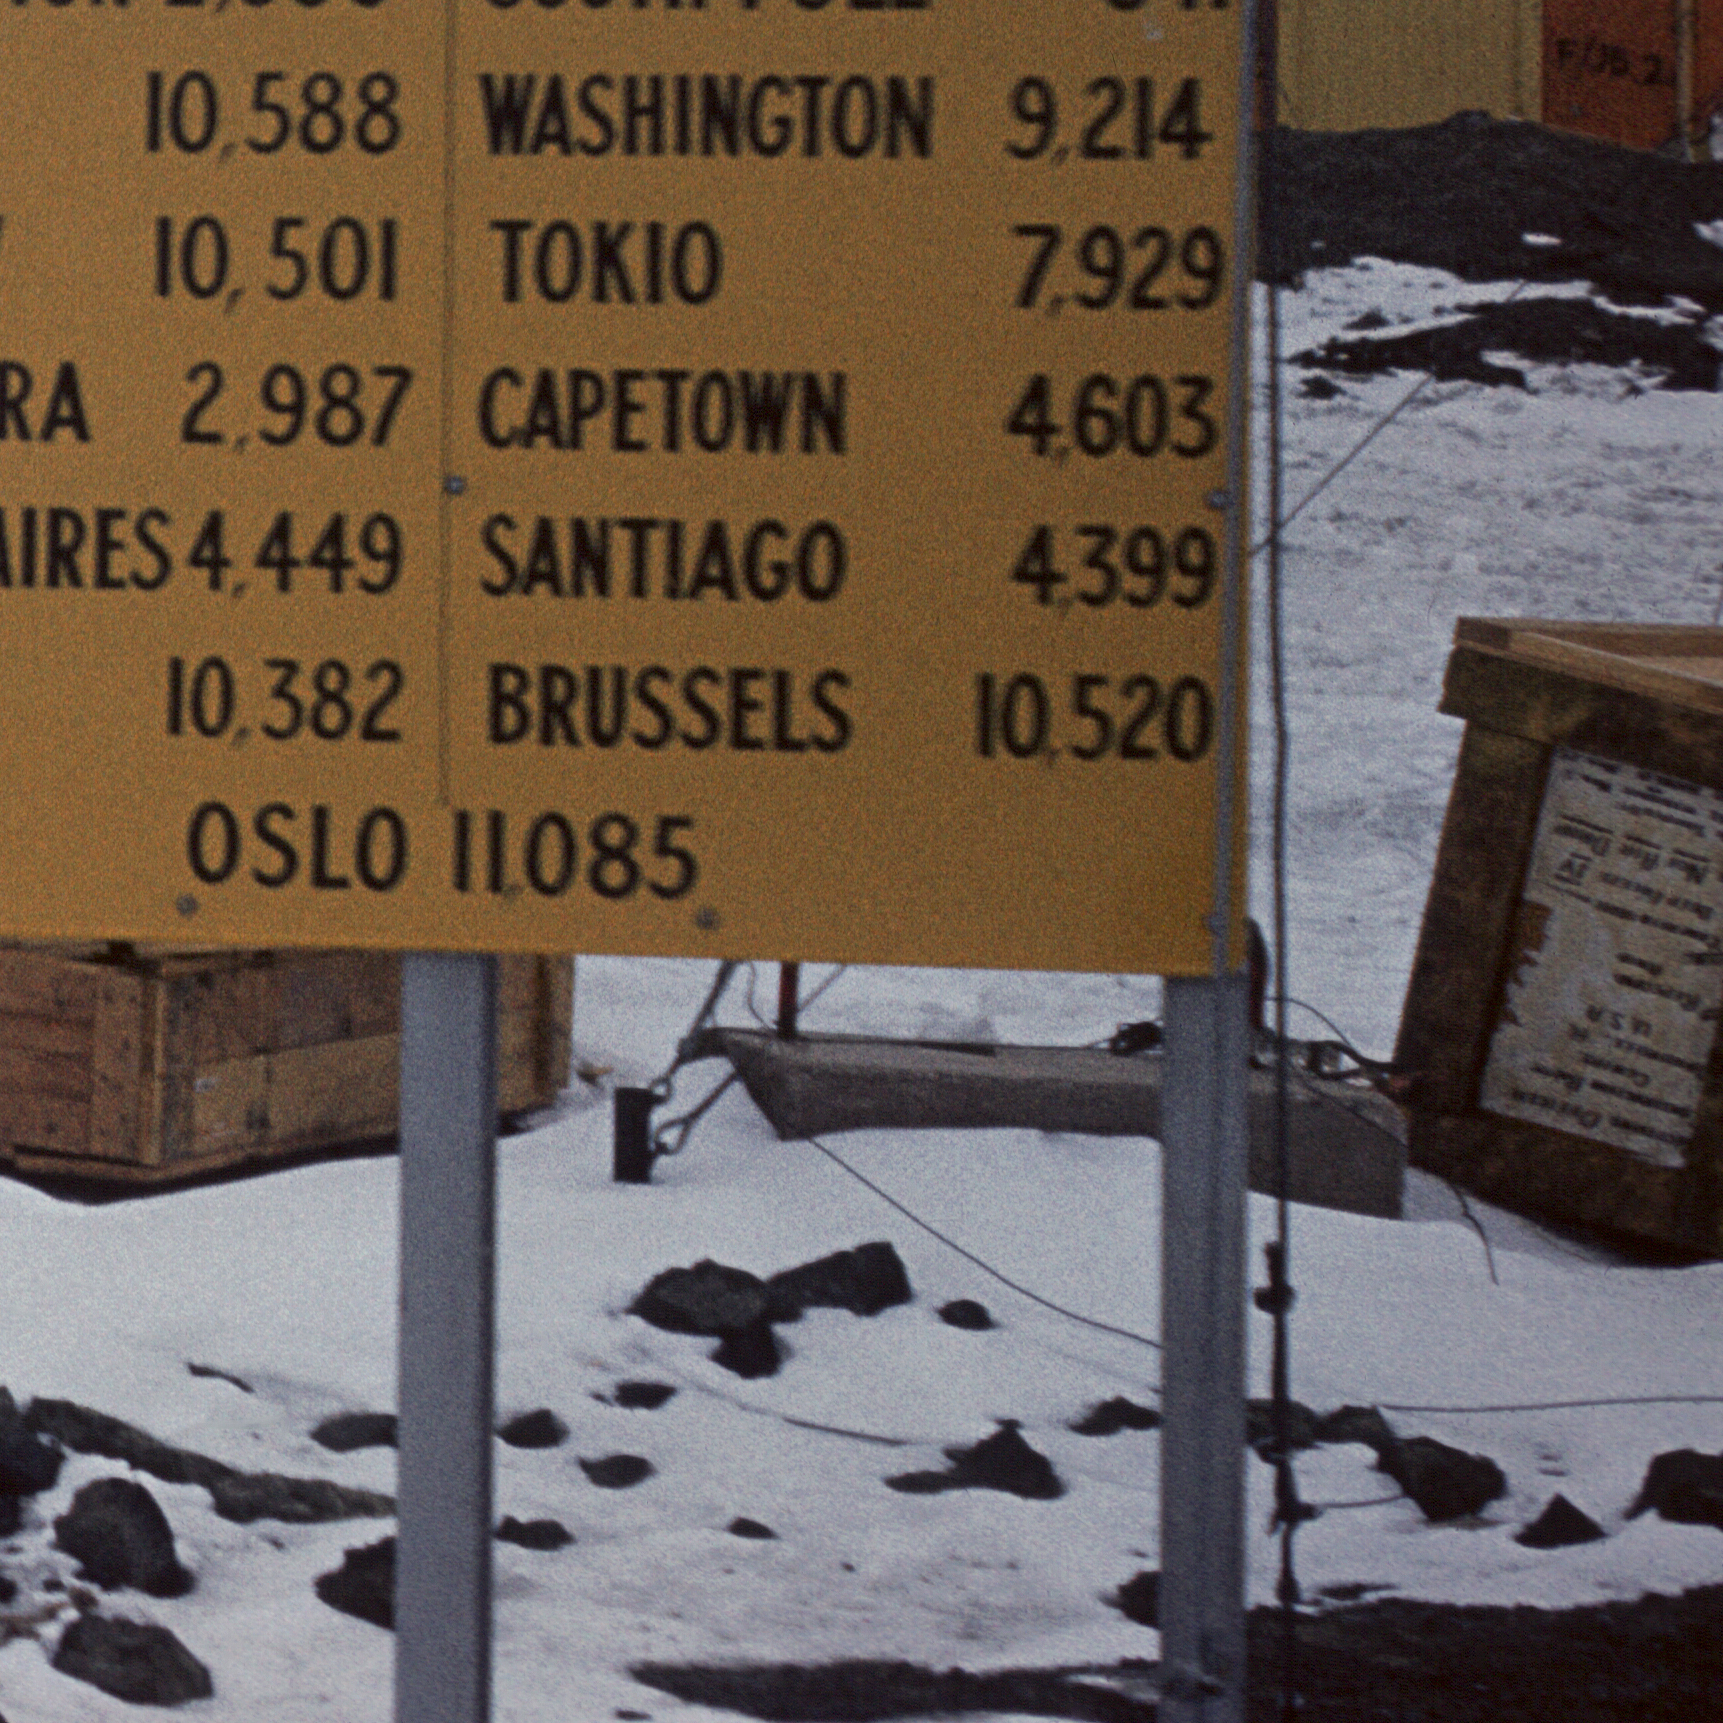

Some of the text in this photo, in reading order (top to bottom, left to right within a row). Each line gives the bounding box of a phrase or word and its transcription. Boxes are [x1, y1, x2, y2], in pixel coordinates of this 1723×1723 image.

[145, 69, 403, 157] 10,588
[479, 73, 1215, 161] WASHINGTON 9,214
[489, 219, 1229, 312] TOKIO 7,929
[181, 360, 415, 449] 2,987
[478, 366, 1222, 460] CAPETOWN 4,603
[187, 509, 404, 596] 4,449
[481, 513, 1220, 611] SANTIAGO 4,399
[166, 655, 406, 744] 10,382
[488, 662, 1217, 765] BRUSSELS 10,520
[186, 800, 410, 893] OSLO
